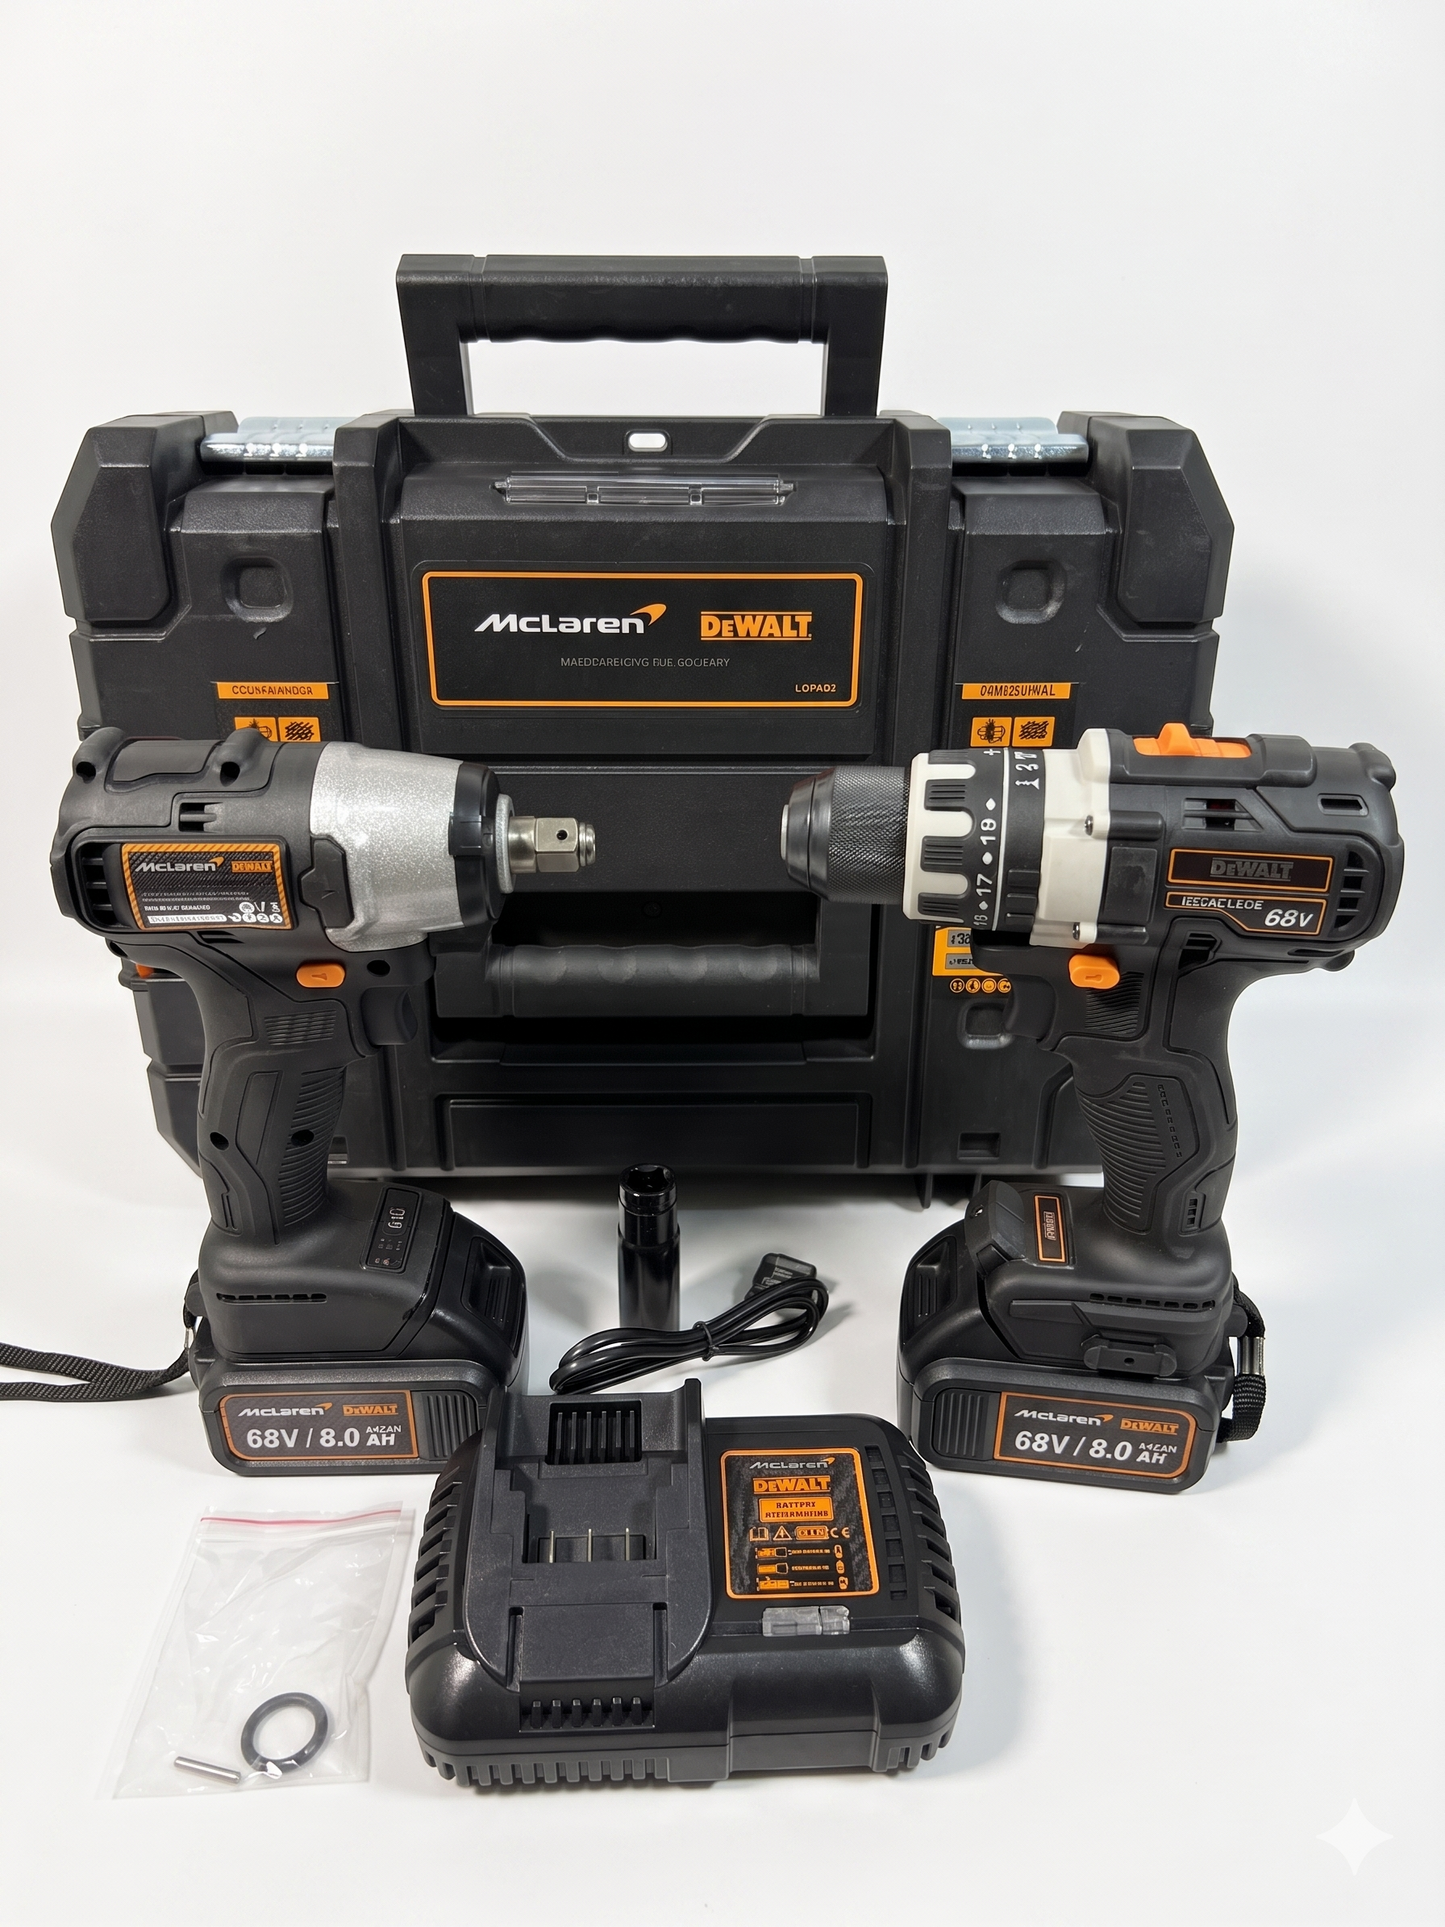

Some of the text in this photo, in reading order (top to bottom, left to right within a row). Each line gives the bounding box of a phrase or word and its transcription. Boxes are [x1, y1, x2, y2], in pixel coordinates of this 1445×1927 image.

[474, 612, 812, 640] McLaren DeWALT
[135, 862, 217, 872] McLaren
[1210, 857, 1294, 882] DeWALT
[976, 873, 993, 897] 17
[1264, 908, 1314, 928] 68V
[238, 1406, 325, 1417] McLaren
[1014, 1409, 1102, 1427] McLaren
[246, 1428, 299, 1448] 68V
[319, 1427, 361, 1448] 8.0
[366, 1433, 396, 1447] AH
[1014, 1430, 1070, 1455] 68V
[1088, 1438, 1133, 1461] 8.0
[1136, 1451, 1168, 1465] AH
[753, 1475, 831, 1495] DeWALT
